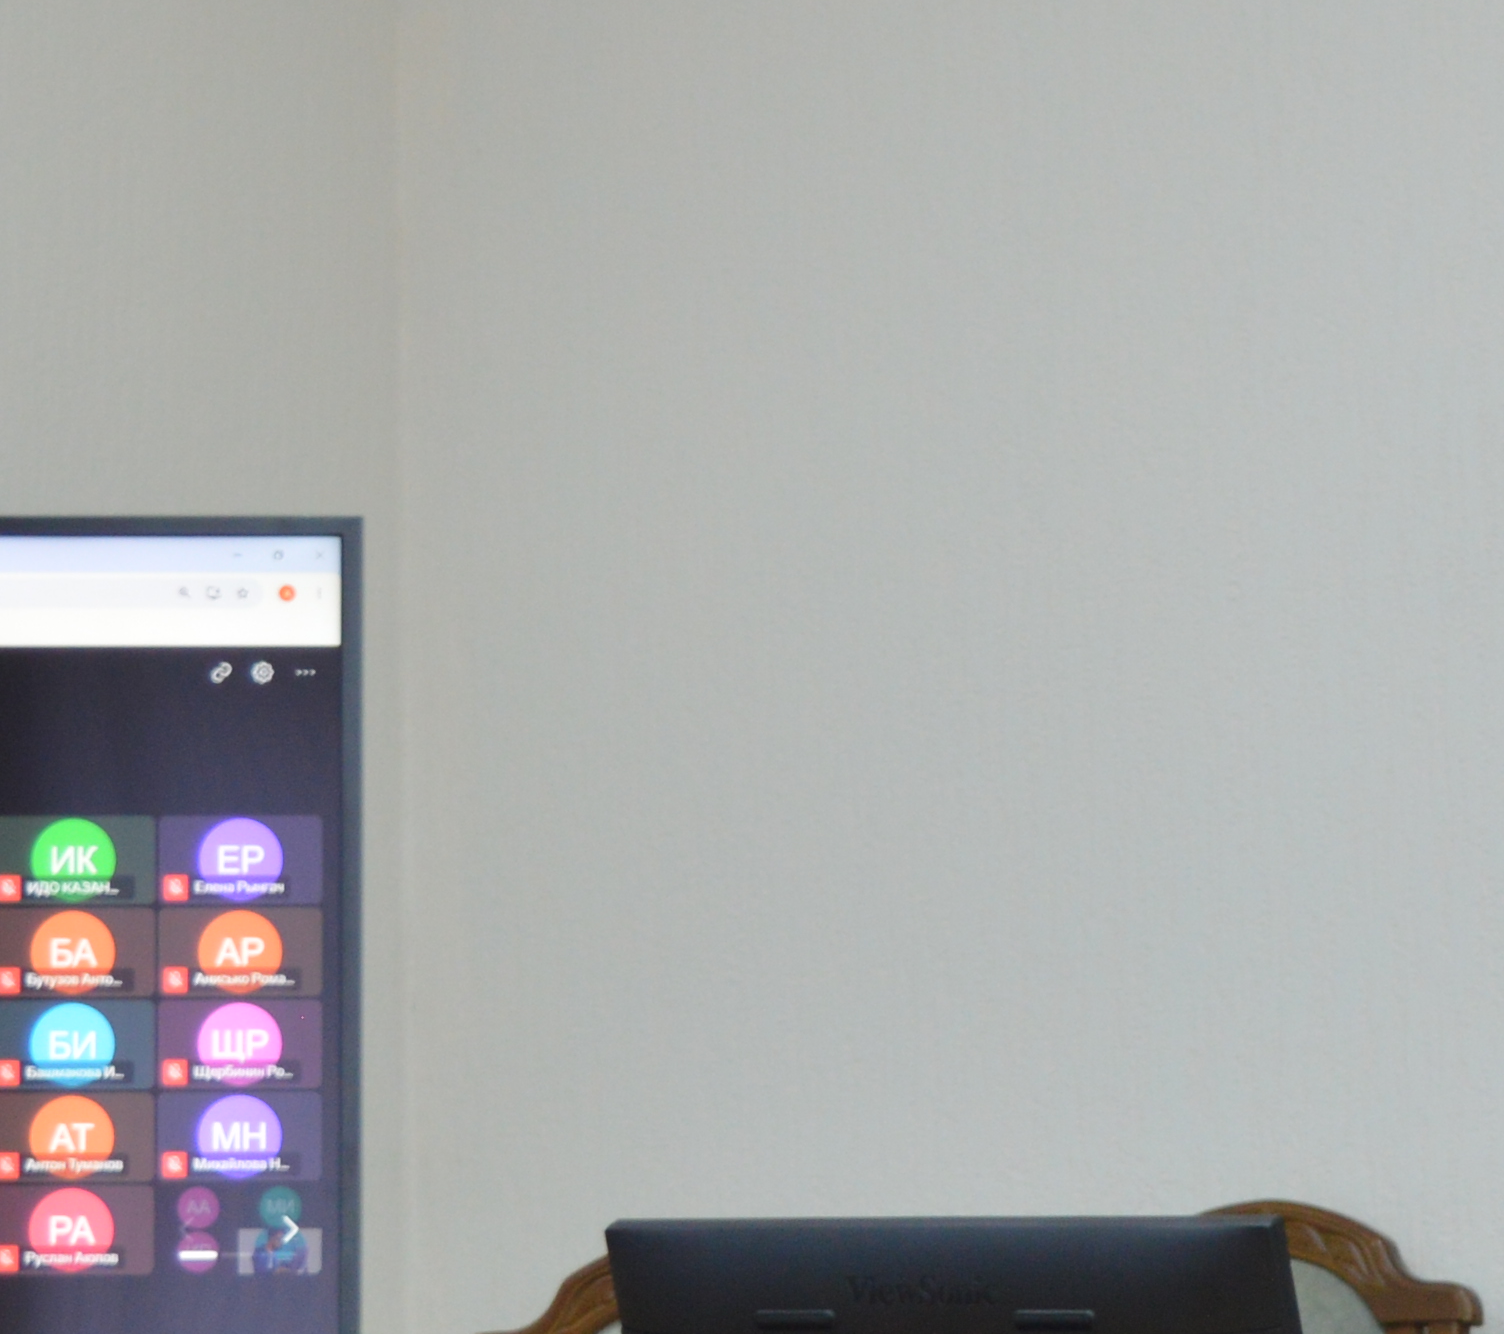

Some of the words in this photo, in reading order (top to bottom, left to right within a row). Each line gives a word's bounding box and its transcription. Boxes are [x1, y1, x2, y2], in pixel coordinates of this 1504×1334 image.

[50, 845, 98, 875] ИК
[217, 845, 265, 875] ЕР
[49, 937, 98, 968] БА
[215, 937, 265, 968] АР
[48, 1030, 96, 1061] БИ
[211, 1029, 269, 1063] ЩР
[49, 1122, 95, 1154] АТ
[211, 1121, 267, 1152] МН
[48, 1214, 96, 1246] РА
